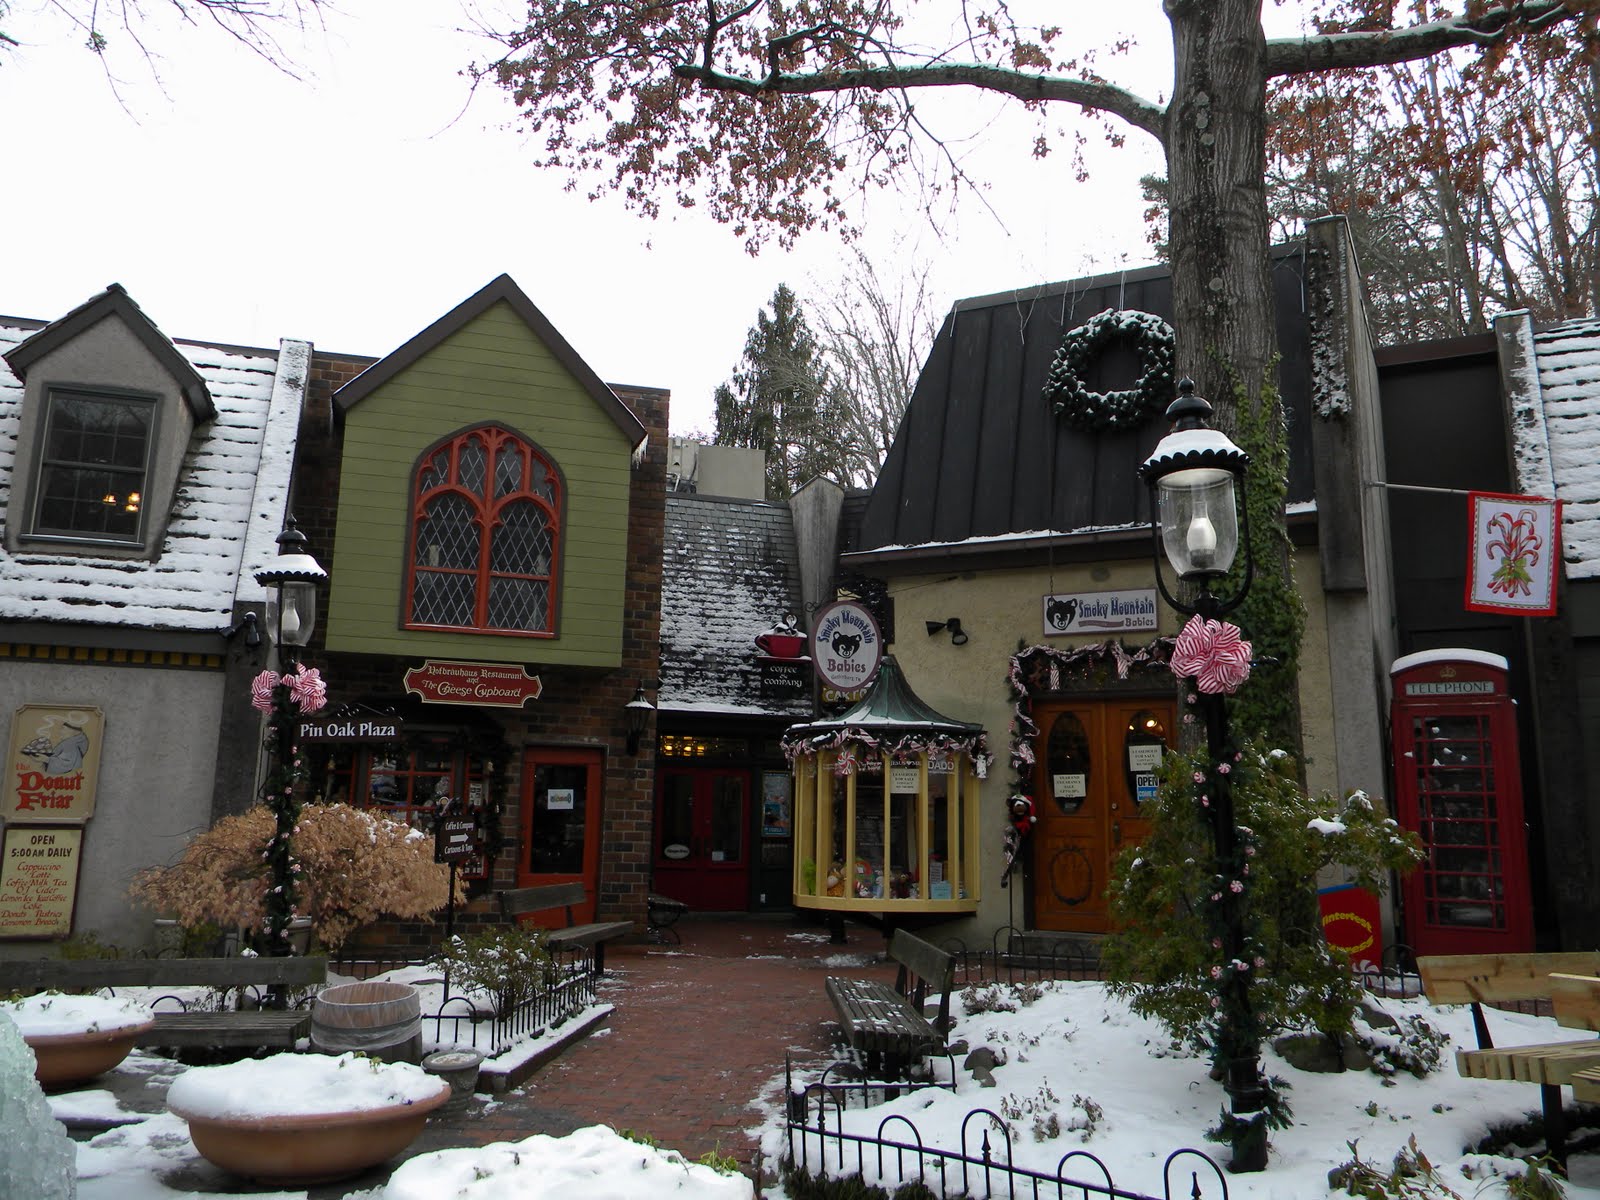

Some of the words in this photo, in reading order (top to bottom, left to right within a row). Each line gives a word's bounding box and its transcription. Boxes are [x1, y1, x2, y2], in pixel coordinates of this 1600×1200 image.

[1079, 599, 1109, 619] Smoky
[1110, 597, 1154, 615] Mountain
[817, 615, 841, 643] Smoky
[841, 609, 876, 644] Mountain
[1125, 617, 1154, 627] Babies
[827, 658, 866, 673] Babies
[480, 669, 522, 679] Restaurant
[421, 680, 437, 689] The
[437, 682, 472, 696] Cheese
[475, 684, 521, 698] Cupboard
[1410, 682, 1490, 694] TELEPHONE
[300, 723, 323, 737] Pin
[326, 722, 356, 737] Oak
[359, 722, 396, 737] Plaza
[16, 771, 85, 791] Donut
[1137, 776, 1157, 787] OPEN
[16, 790, 74, 811] Friar
[30, 835, 55, 845] OPEN
[11, 848, 32, 857] 5:00
[32, 849, 45, 857] AM
[47, 847, 73, 857] DAILY
[17, 861, 62, 872] Cappuccino
[36, 886, 59, 894] Cider
